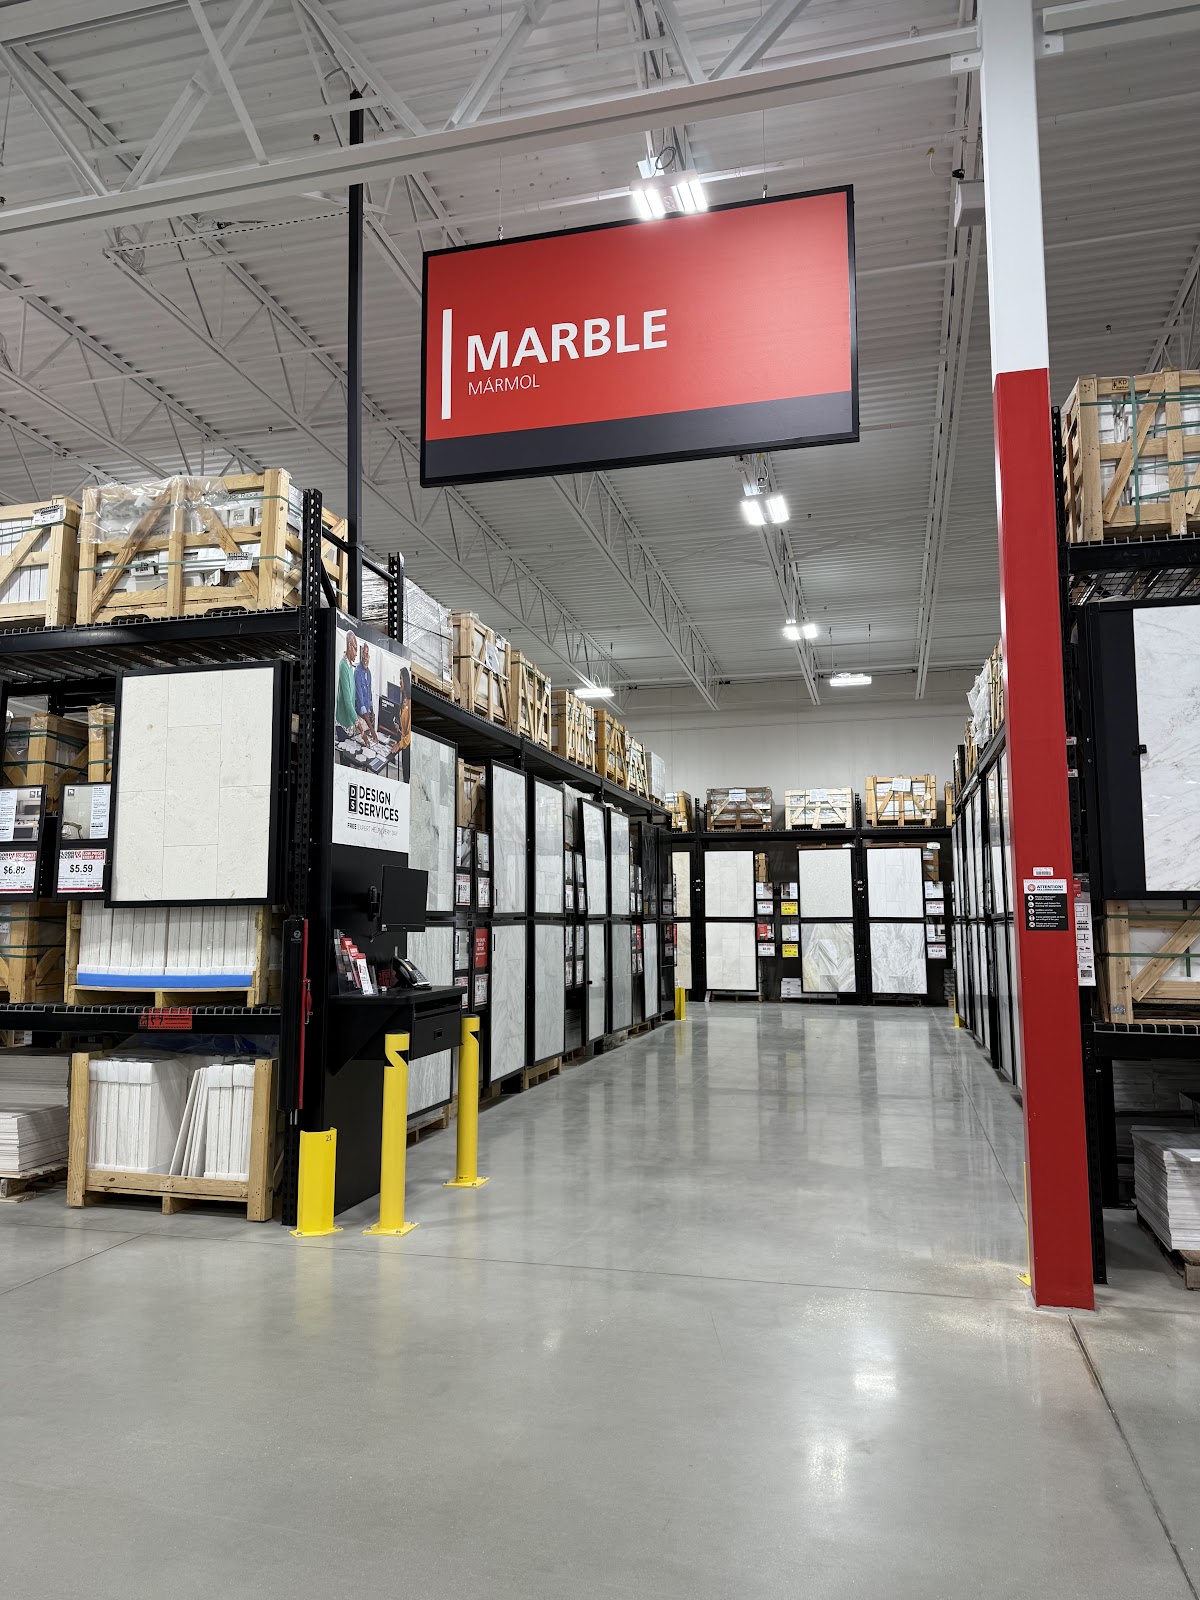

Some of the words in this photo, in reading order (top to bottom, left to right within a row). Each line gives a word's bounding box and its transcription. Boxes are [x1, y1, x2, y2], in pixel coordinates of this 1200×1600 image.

[467, 308, 668, 373] MARBLE
[468, 373, 540, 396] MÁRMOL
[359, 785, 391, 805] DESIGN
[358, 801, 399, 822] SERVICES
[3, 865, 26, 875] $6.89
[69, 864, 93, 873] $5.59
